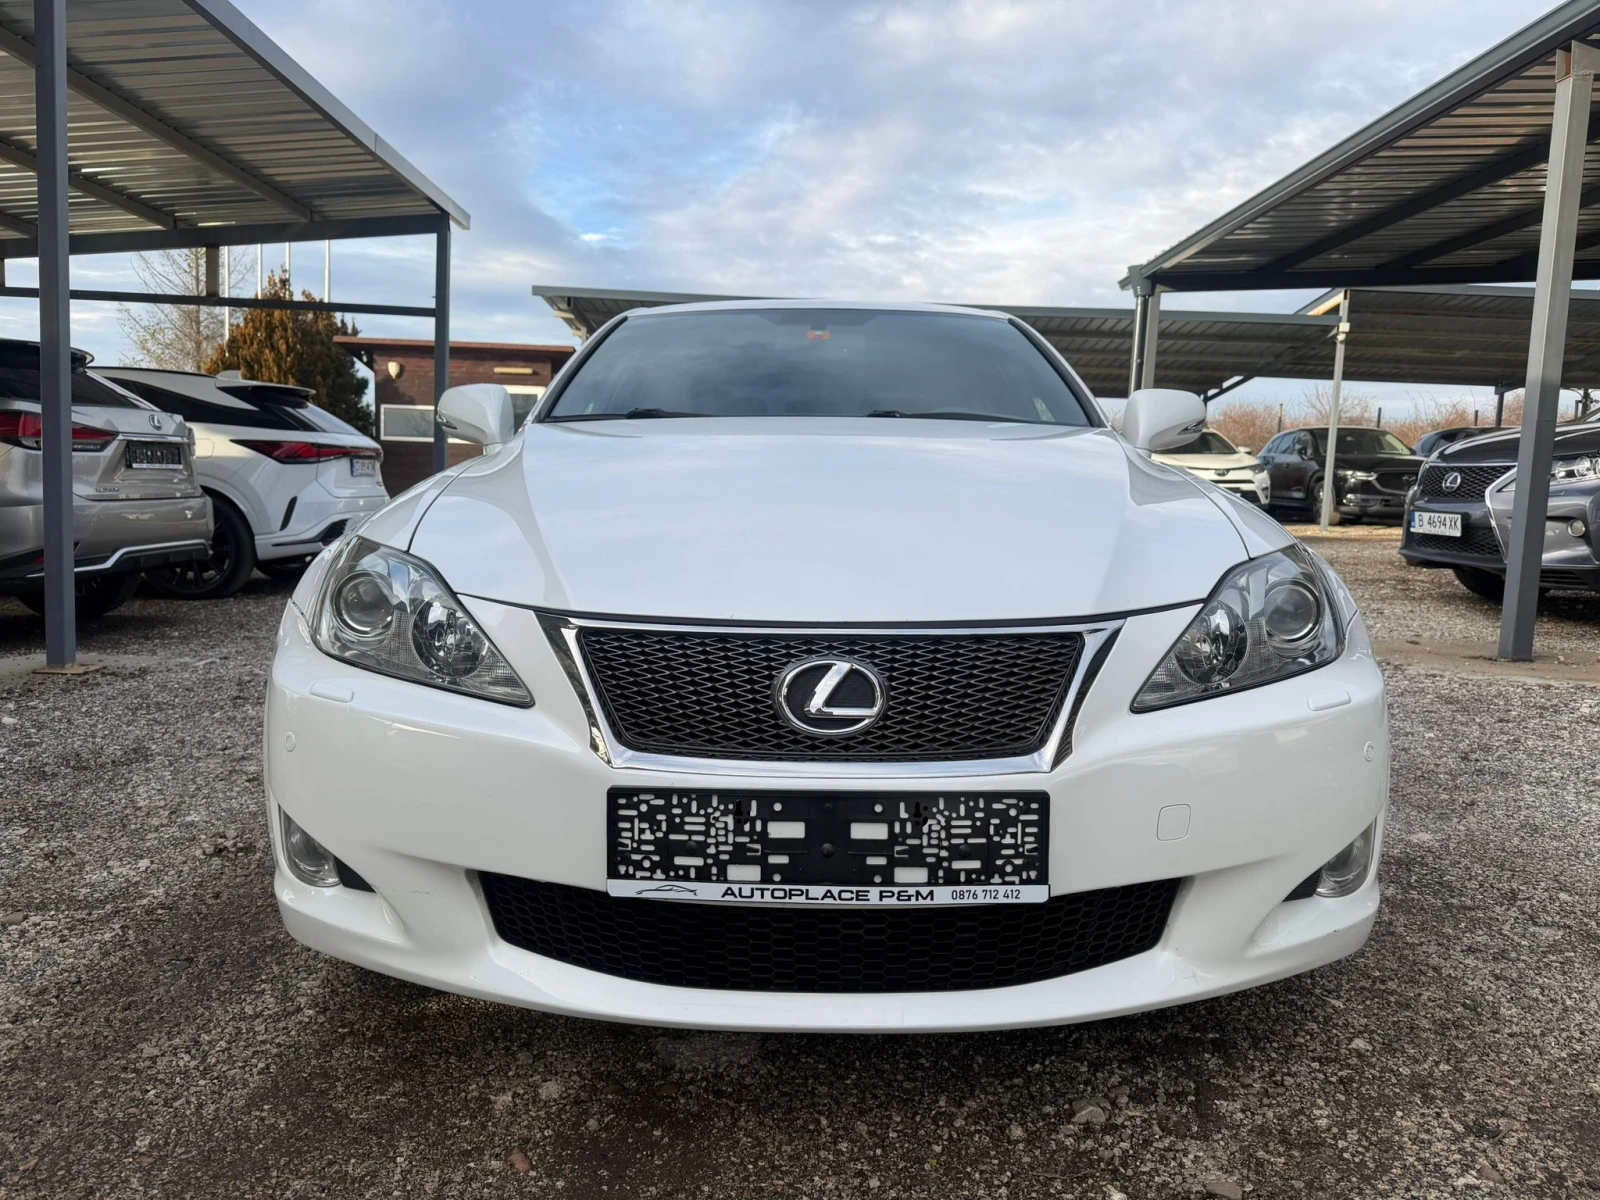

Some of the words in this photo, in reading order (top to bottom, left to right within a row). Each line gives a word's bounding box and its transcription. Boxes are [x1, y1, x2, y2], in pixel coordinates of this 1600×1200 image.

[1418, 513, 1424, 528] B
[1427, 514, 1447, 530] 4694
[1448, 515, 1460, 531] XK
[720, 886, 871, 902] AUTOPLACE
[878, 889, 935, 902] P&M
[951, 889, 979, 901] 0876
[981, 889, 1000, 900] 712
[1002, 888, 1022, 900] 412
